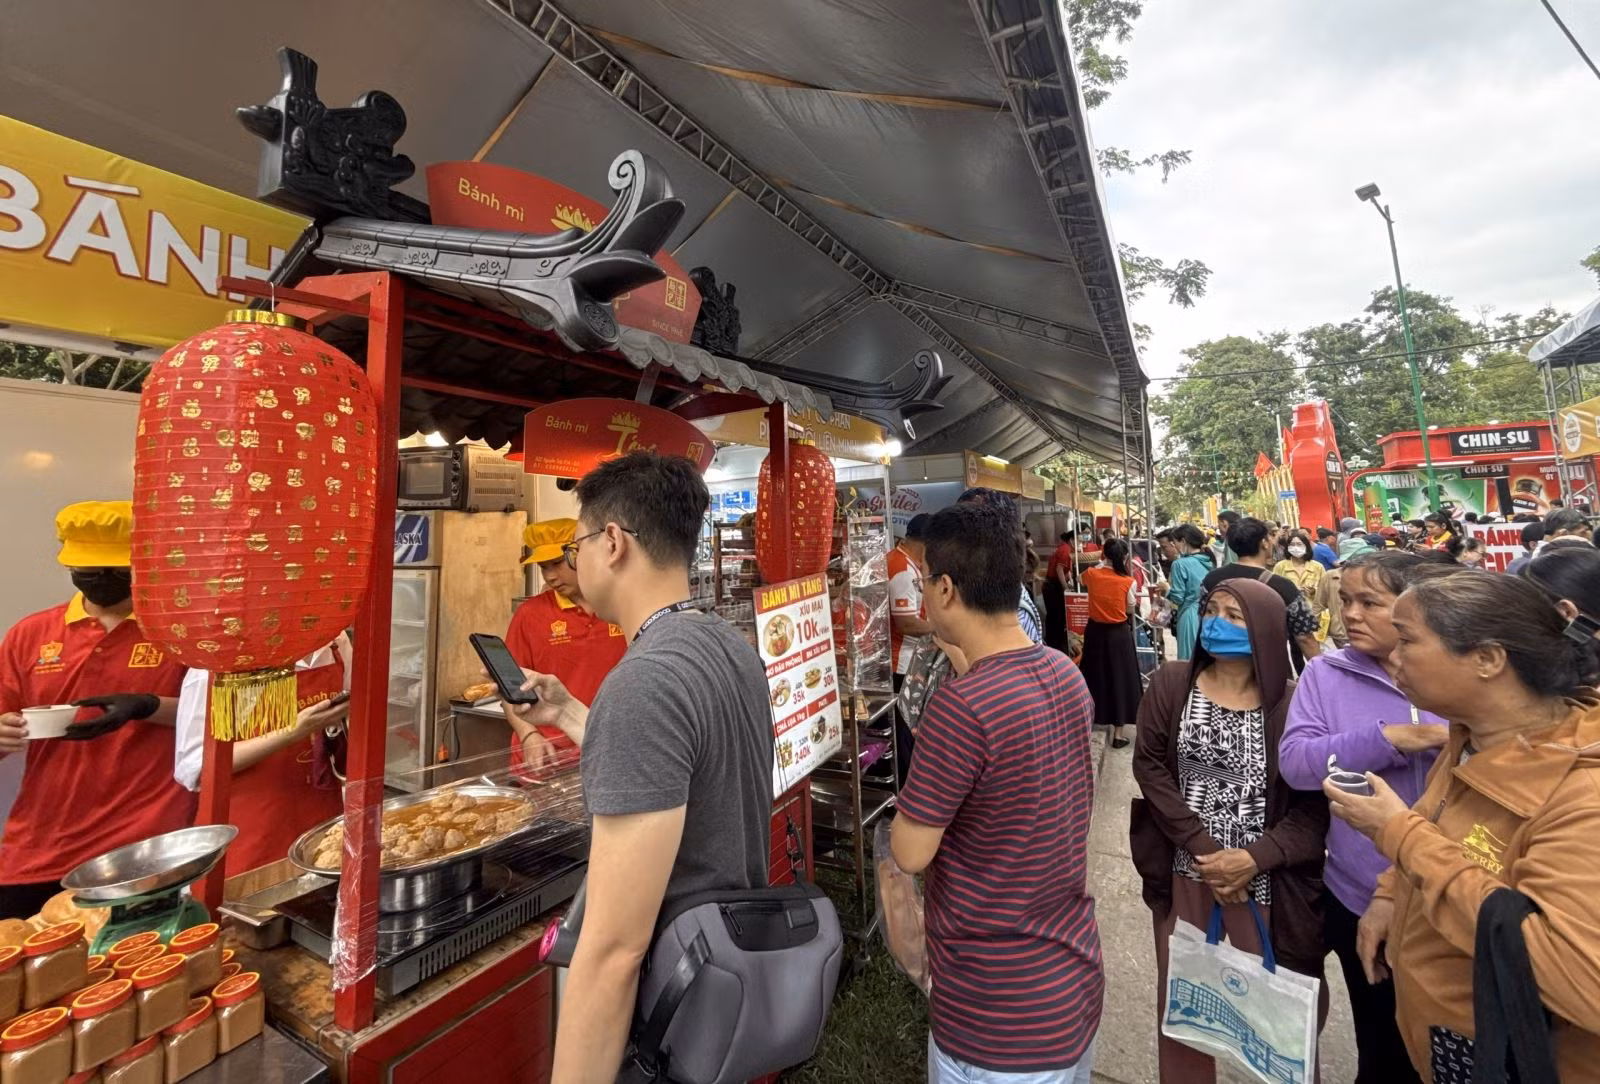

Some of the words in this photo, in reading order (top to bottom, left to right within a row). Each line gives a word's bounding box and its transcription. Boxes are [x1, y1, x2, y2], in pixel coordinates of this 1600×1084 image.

[1458, 430, 1529, 448] CHIN-SU
[1464, 464, 1504, 475] CHIN-SU
[761, 587, 788, 609] BÁNH
